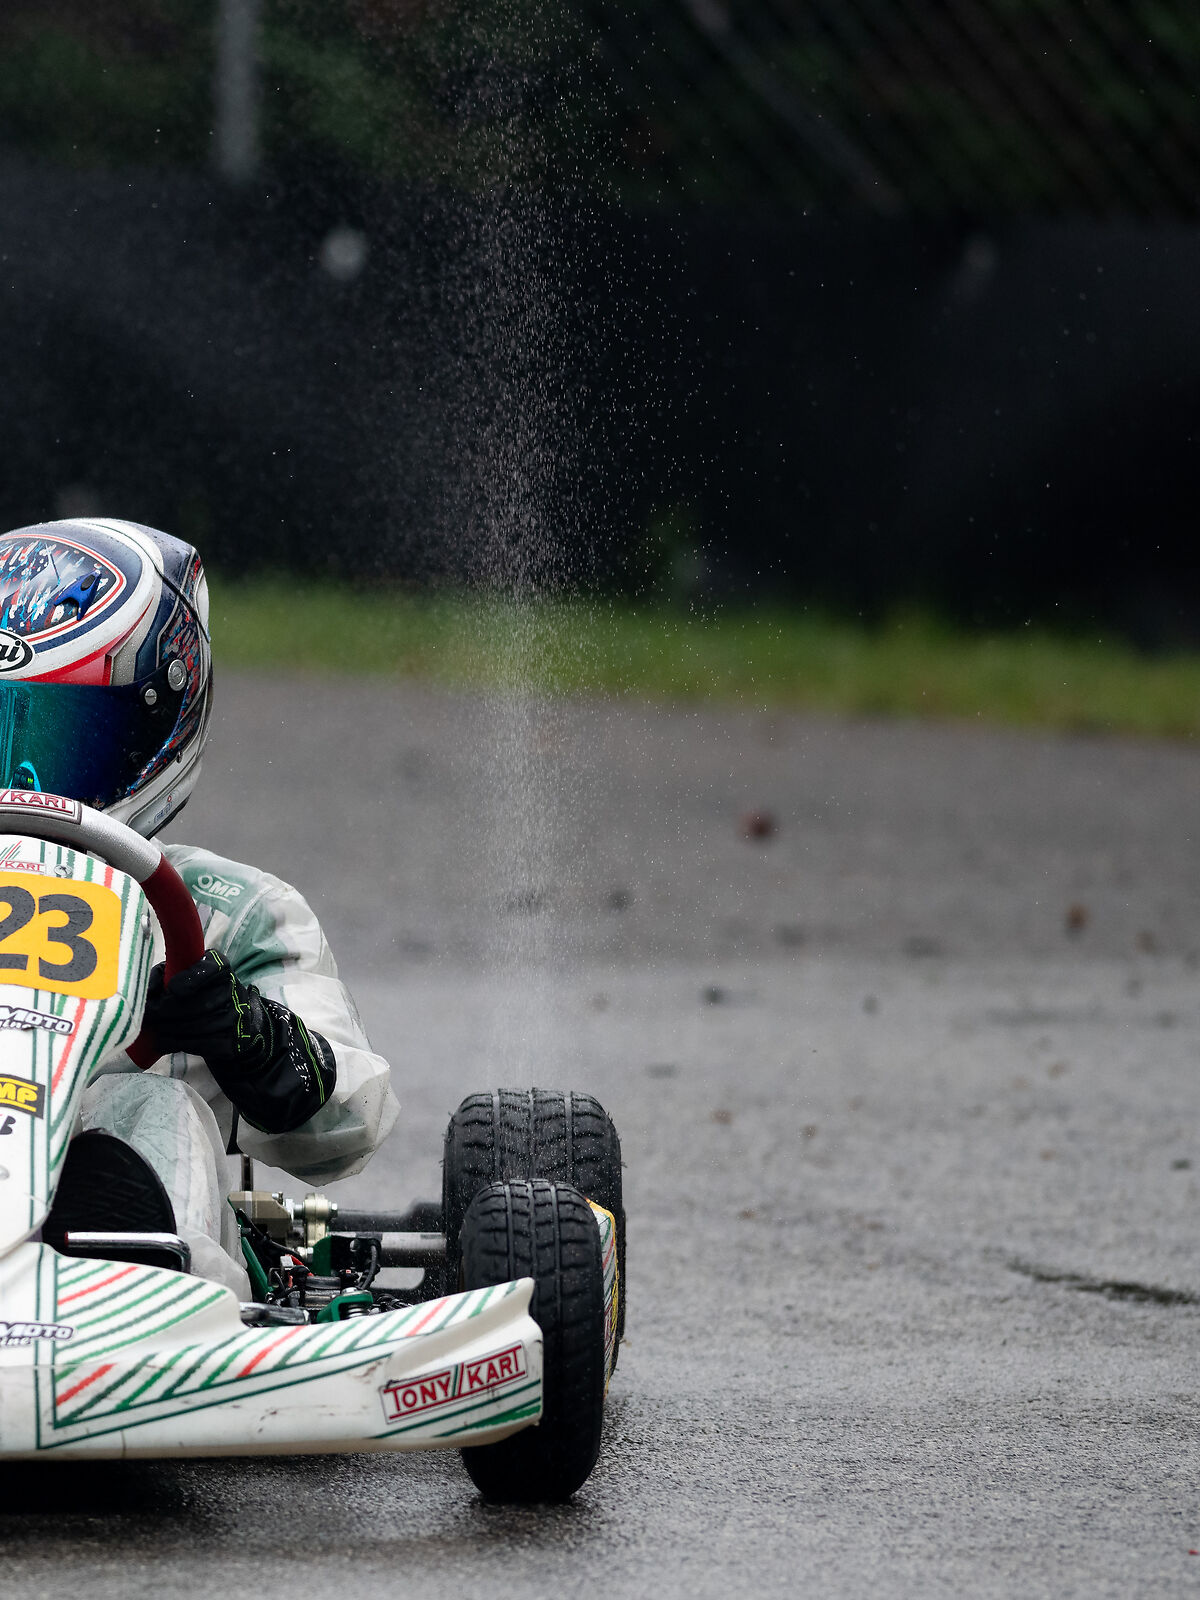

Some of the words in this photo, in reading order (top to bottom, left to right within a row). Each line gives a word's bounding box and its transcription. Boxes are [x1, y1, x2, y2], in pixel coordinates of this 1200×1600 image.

[11, 790, 70, 808] KART
[5, 861, 43, 871] KART
[197, 875, 240, 897] OMP
[384, 1371, 451, 1411] TONY
[466, 1345, 522, 1389] KART
